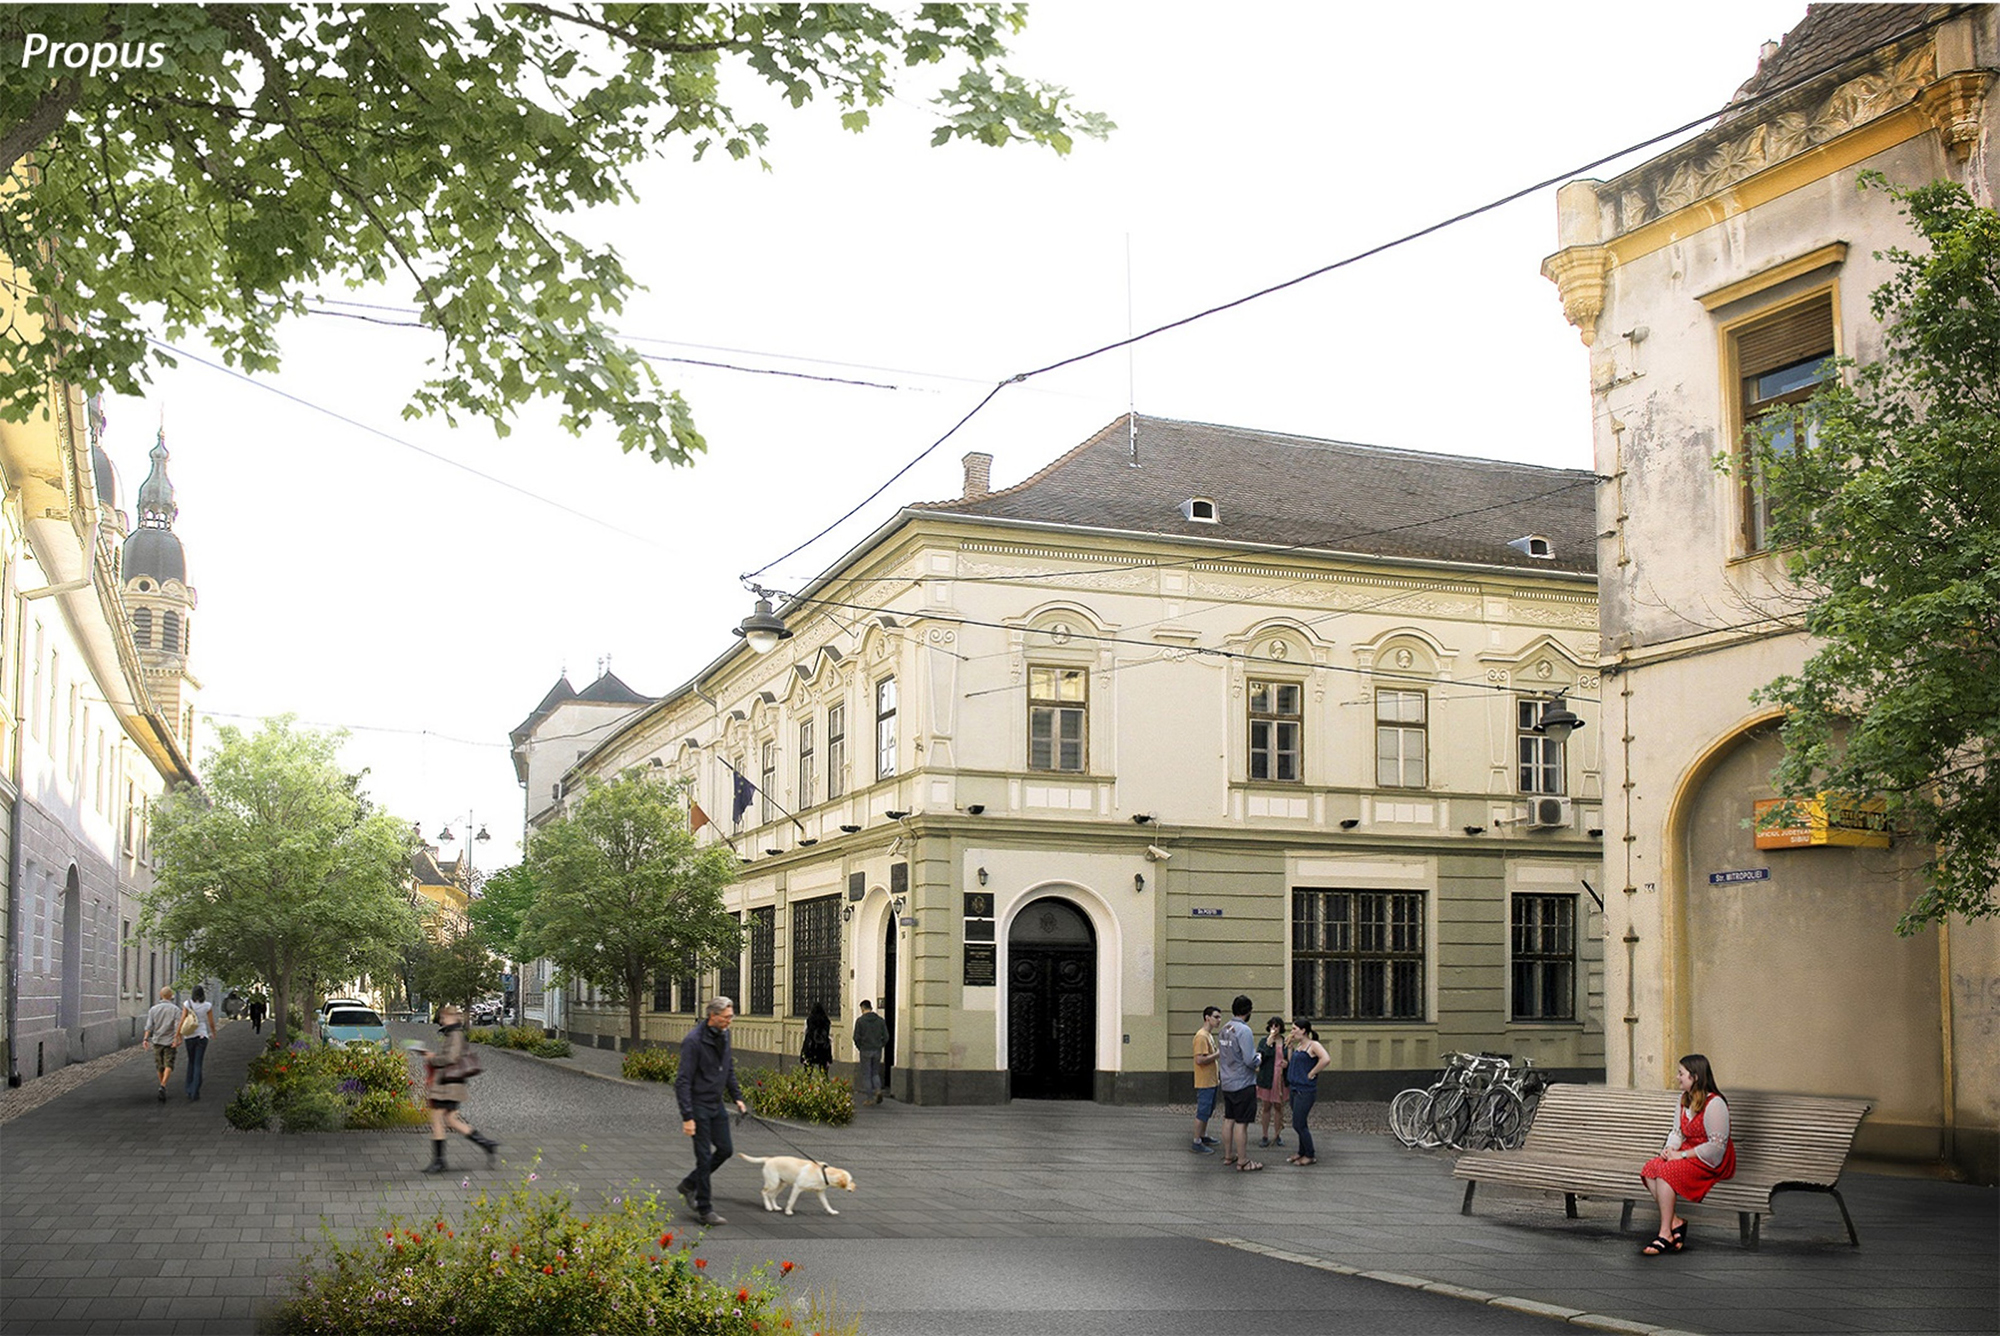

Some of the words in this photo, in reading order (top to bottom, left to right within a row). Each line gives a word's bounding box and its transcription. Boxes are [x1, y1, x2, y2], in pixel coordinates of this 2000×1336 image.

[1790, 835, 1810, 843] SIBIU
[1715, 874, 1725, 882] Str.
[1726, 870, 1762, 881] MITROPOLIEI
